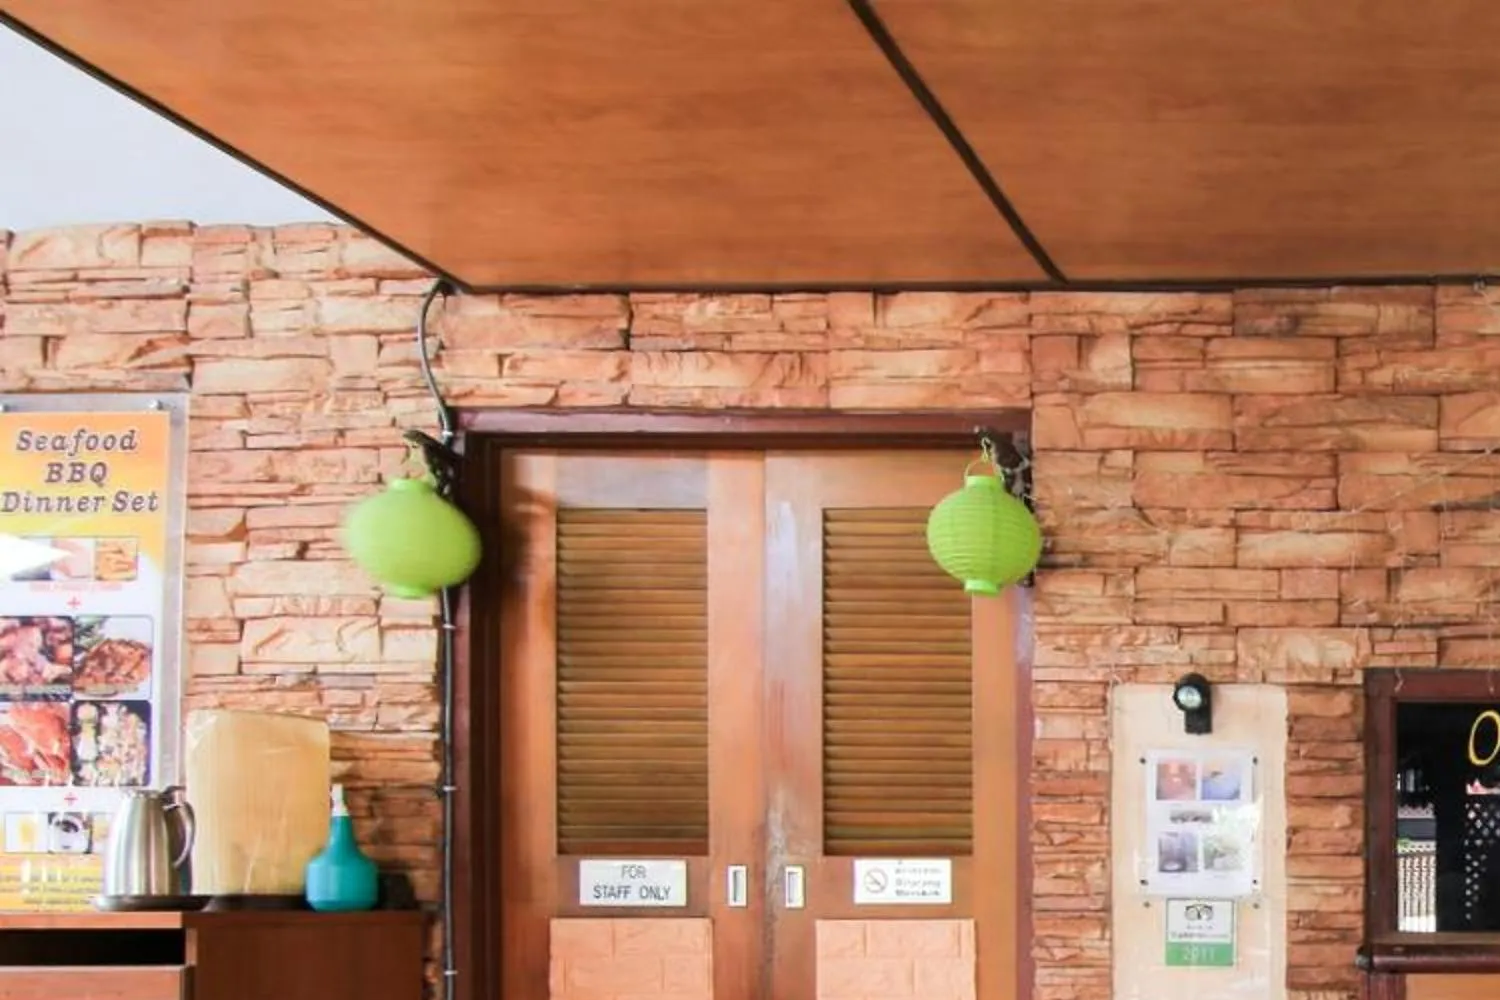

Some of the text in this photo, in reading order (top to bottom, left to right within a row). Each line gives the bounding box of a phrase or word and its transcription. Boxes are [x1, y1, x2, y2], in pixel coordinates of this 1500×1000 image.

[16, 428, 138, 456] Seafood
[45, 461, 109, 487] BBQ
[1, 490, 159, 513] Dinner Set
[621, 864, 647, 879] FOR
[593, 885, 671, 900] STAFF ONLY
